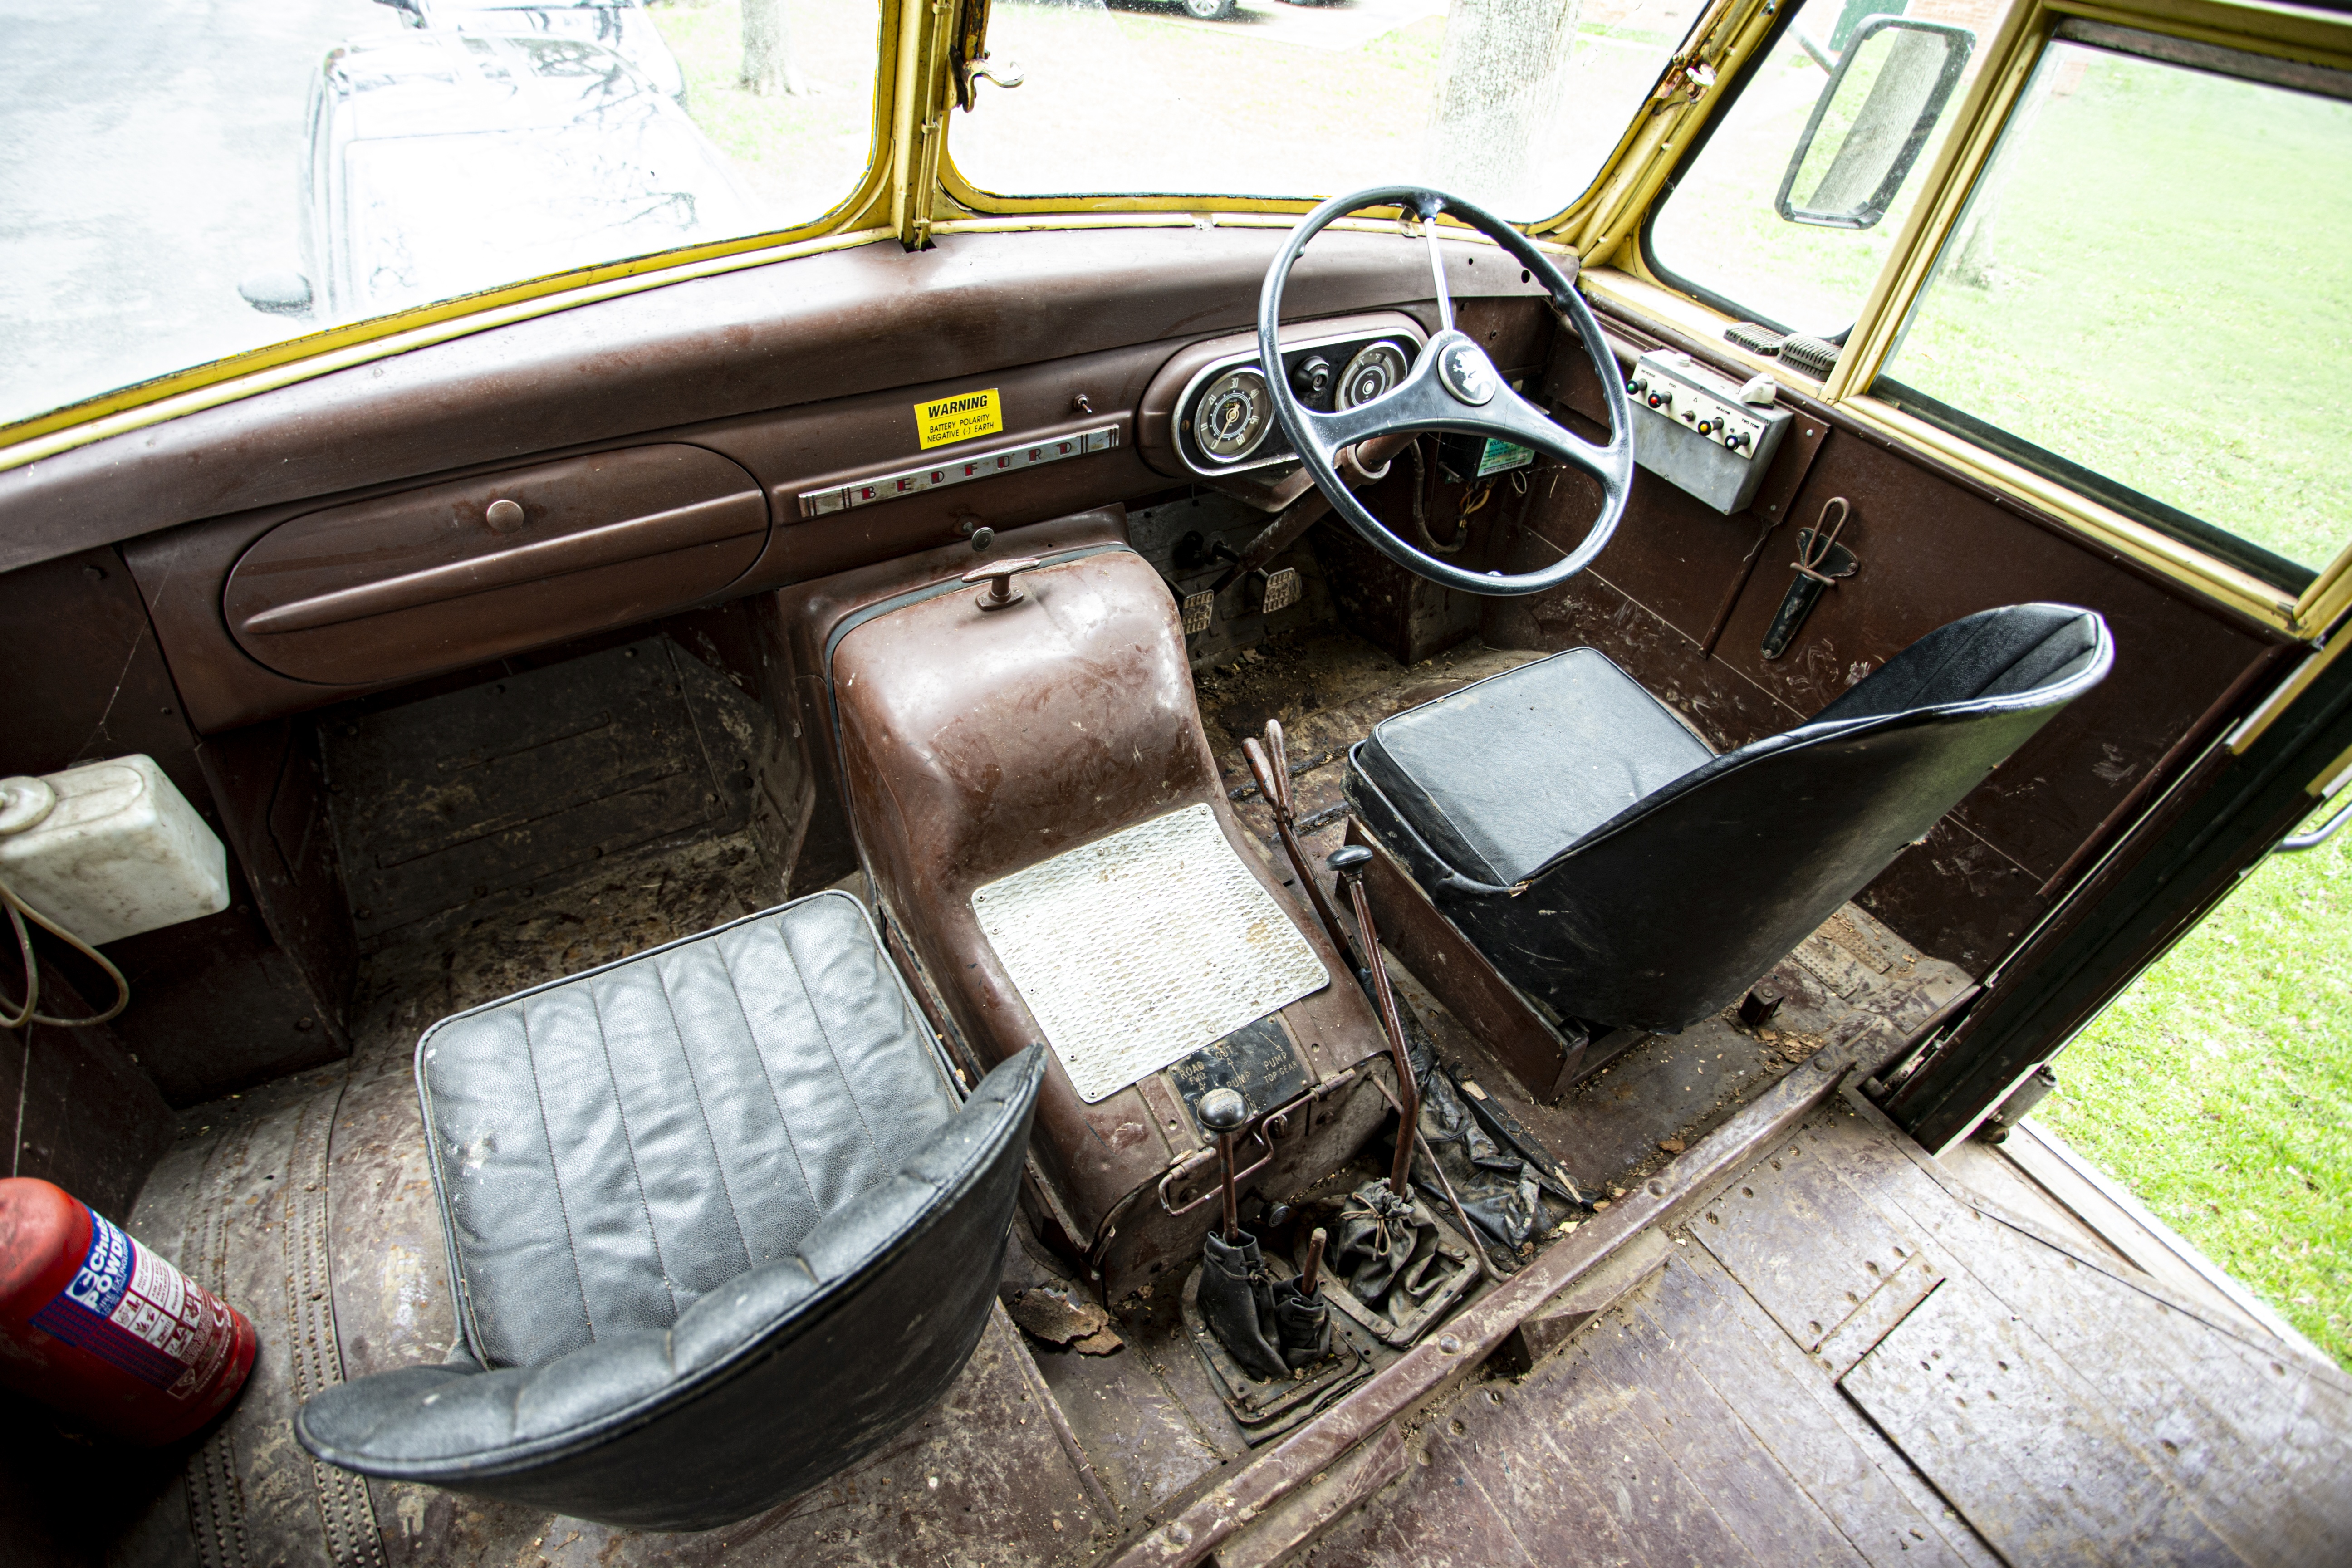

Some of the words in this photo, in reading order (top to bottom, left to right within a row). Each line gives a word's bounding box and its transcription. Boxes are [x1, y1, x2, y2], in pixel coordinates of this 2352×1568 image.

[1641, 369, 1656, 378] REVERSE
[1230, 377, 1239, 388] 30
[1208, 394, 1216, 405] 20
[1250, 389, 1259, 399] 40
[928, 395, 987, 418] WARNING
[1715, 406, 1730, 415] BEACON
[930, 421, 956, 433] BATTERY
[960, 414, 990, 426] POLARITY
[1200, 422, 1208, 431] 10
[1250, 415, 1260, 425] 50
[927, 429, 959, 443] NEGATIVE
[975, 422, 994, 432] EARTH
[1210, 439, 1218, 450] 0
[1236, 433, 1245, 446] 60
[862, 441, 1072, 500] BEDFORD
[1215, 1045, 1233, 1060] OUT
[1264, 1052, 1286, 1070] PUMP
[1179, 1061, 1205, 1079] ROAD
[1263, 1072, 1277, 1083] TOP
[1279, 1061, 1298, 1075] GEAR
[1226, 1071, 1250, 1089] PUMP
[1250, 1100, 1257, 1110] N
[95, 1292, 112, 1313] FIRE
[112, 1233, 128, 1293] EXTINGUISH
[177, 1327, 185, 1336] A
